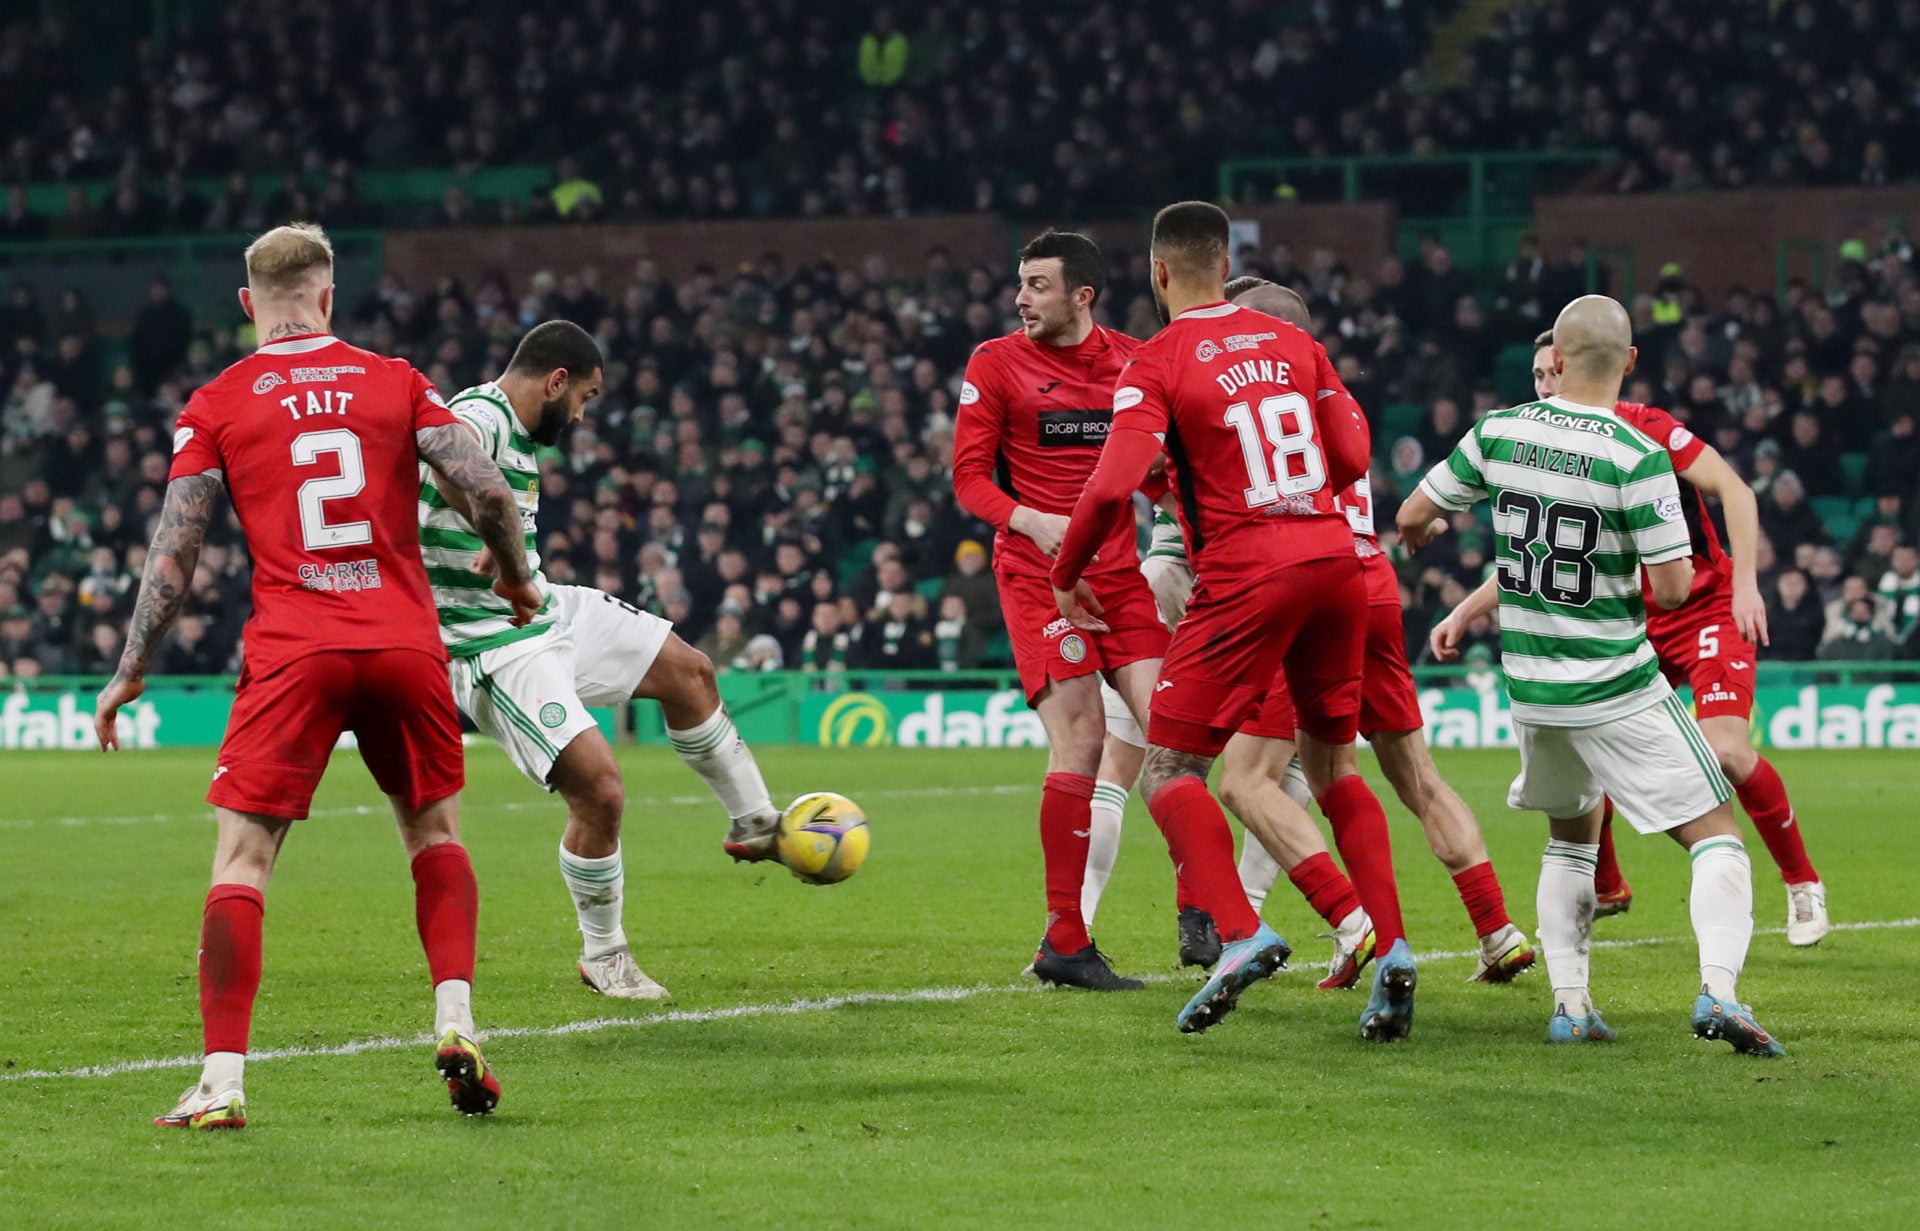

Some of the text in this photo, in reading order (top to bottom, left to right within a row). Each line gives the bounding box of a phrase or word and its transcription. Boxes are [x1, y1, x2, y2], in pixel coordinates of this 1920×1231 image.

[1216, 359, 1290, 396] DUNNE
[280, 391, 354, 420] TAIT
[1518, 406, 1617, 438] MAGNERS
[1045, 422, 1113, 434] DIGBY BROW
[1224, 392, 1326, 508] 18
[1512, 442, 1593, 479] DAIZEN
[290, 428, 373, 551] 2
[1497, 489, 1602, 608] 38
[299, 559, 379, 580] CLARKE
[1043, 618, 1070, 638] ASPR
[1698, 624, 1720, 659] 5
[898, 692, 1049, 747] dafa
[1420, 689, 1519, 748] fab
[1769, 684, 1920, 749] dafa
